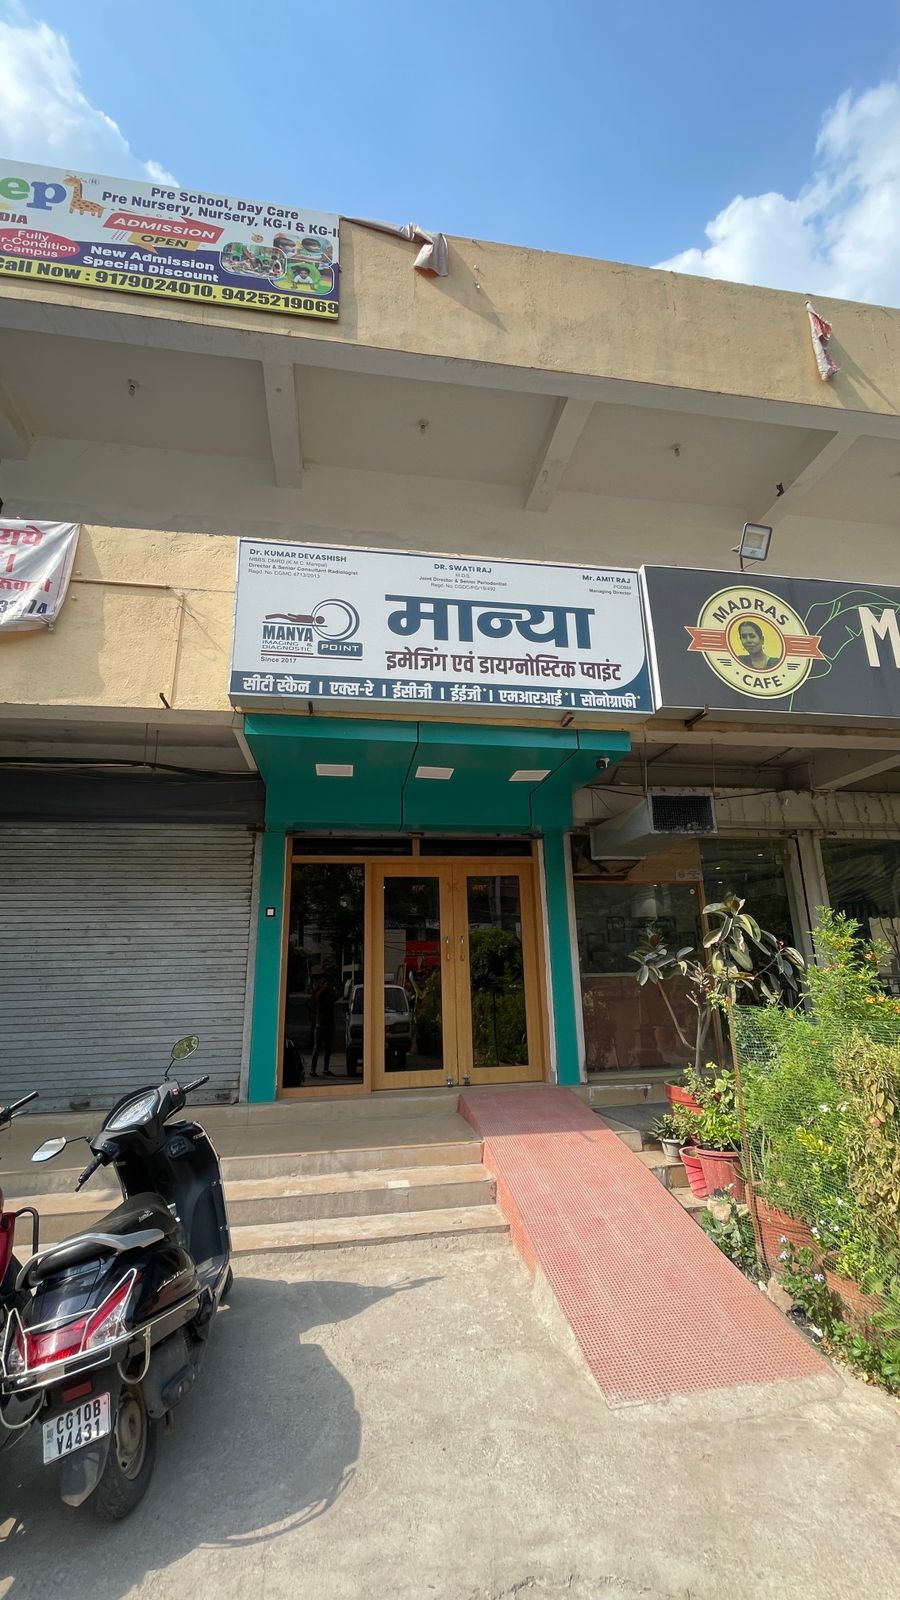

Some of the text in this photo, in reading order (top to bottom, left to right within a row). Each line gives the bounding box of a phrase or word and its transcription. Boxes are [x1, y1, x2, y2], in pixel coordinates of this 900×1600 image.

[102, 192, 128, 205] Pre
[131, 196, 193, 217] Nursery,
[198, 207, 259, 227] Nursery,
[263, 217, 292, 231] KG-I
[296, 223, 305, 232] &
[152, 187, 299, 220] Pre School, Day Care
[18, 230, 49, 242] Fully
[113, 218, 216, 239] ADMISSION
[2, 244, 58, 258] Campus
[140, 235, 189, 248] OPEN
[83, 256, 219, 283] Special Discount
[91, 246, 214, 271] New Admission
[37, 263, 82, 280] Now
[221, 288, 338, 314] 9425219069
[249, 548, 347, 563] Dr. KUMAR DEVASHISH
[297, 566, 327, 574] Consultant
[434, 563, 492, 574] DR. SWATI RAJ
[384, 594, 595, 649] मान्या
[712, 597, 789, 626] MADRAS
[262, 625, 314, 642] MANYA
[321, 643, 360, 653] POINT
[385, 646, 622, 682] इमेजिंग एवं डायग्नोस्टिक प्वाइंट
[243, 674, 637, 709] सीटी स्कैन एक्स-रे ईसीजी ईईजी एमआरआई सोनोग्राफी
[742, 674, 783, 690] CAFE
[56, 1398, 101, 1435] CG10B
[56, 1418, 100, 1455] V4431
